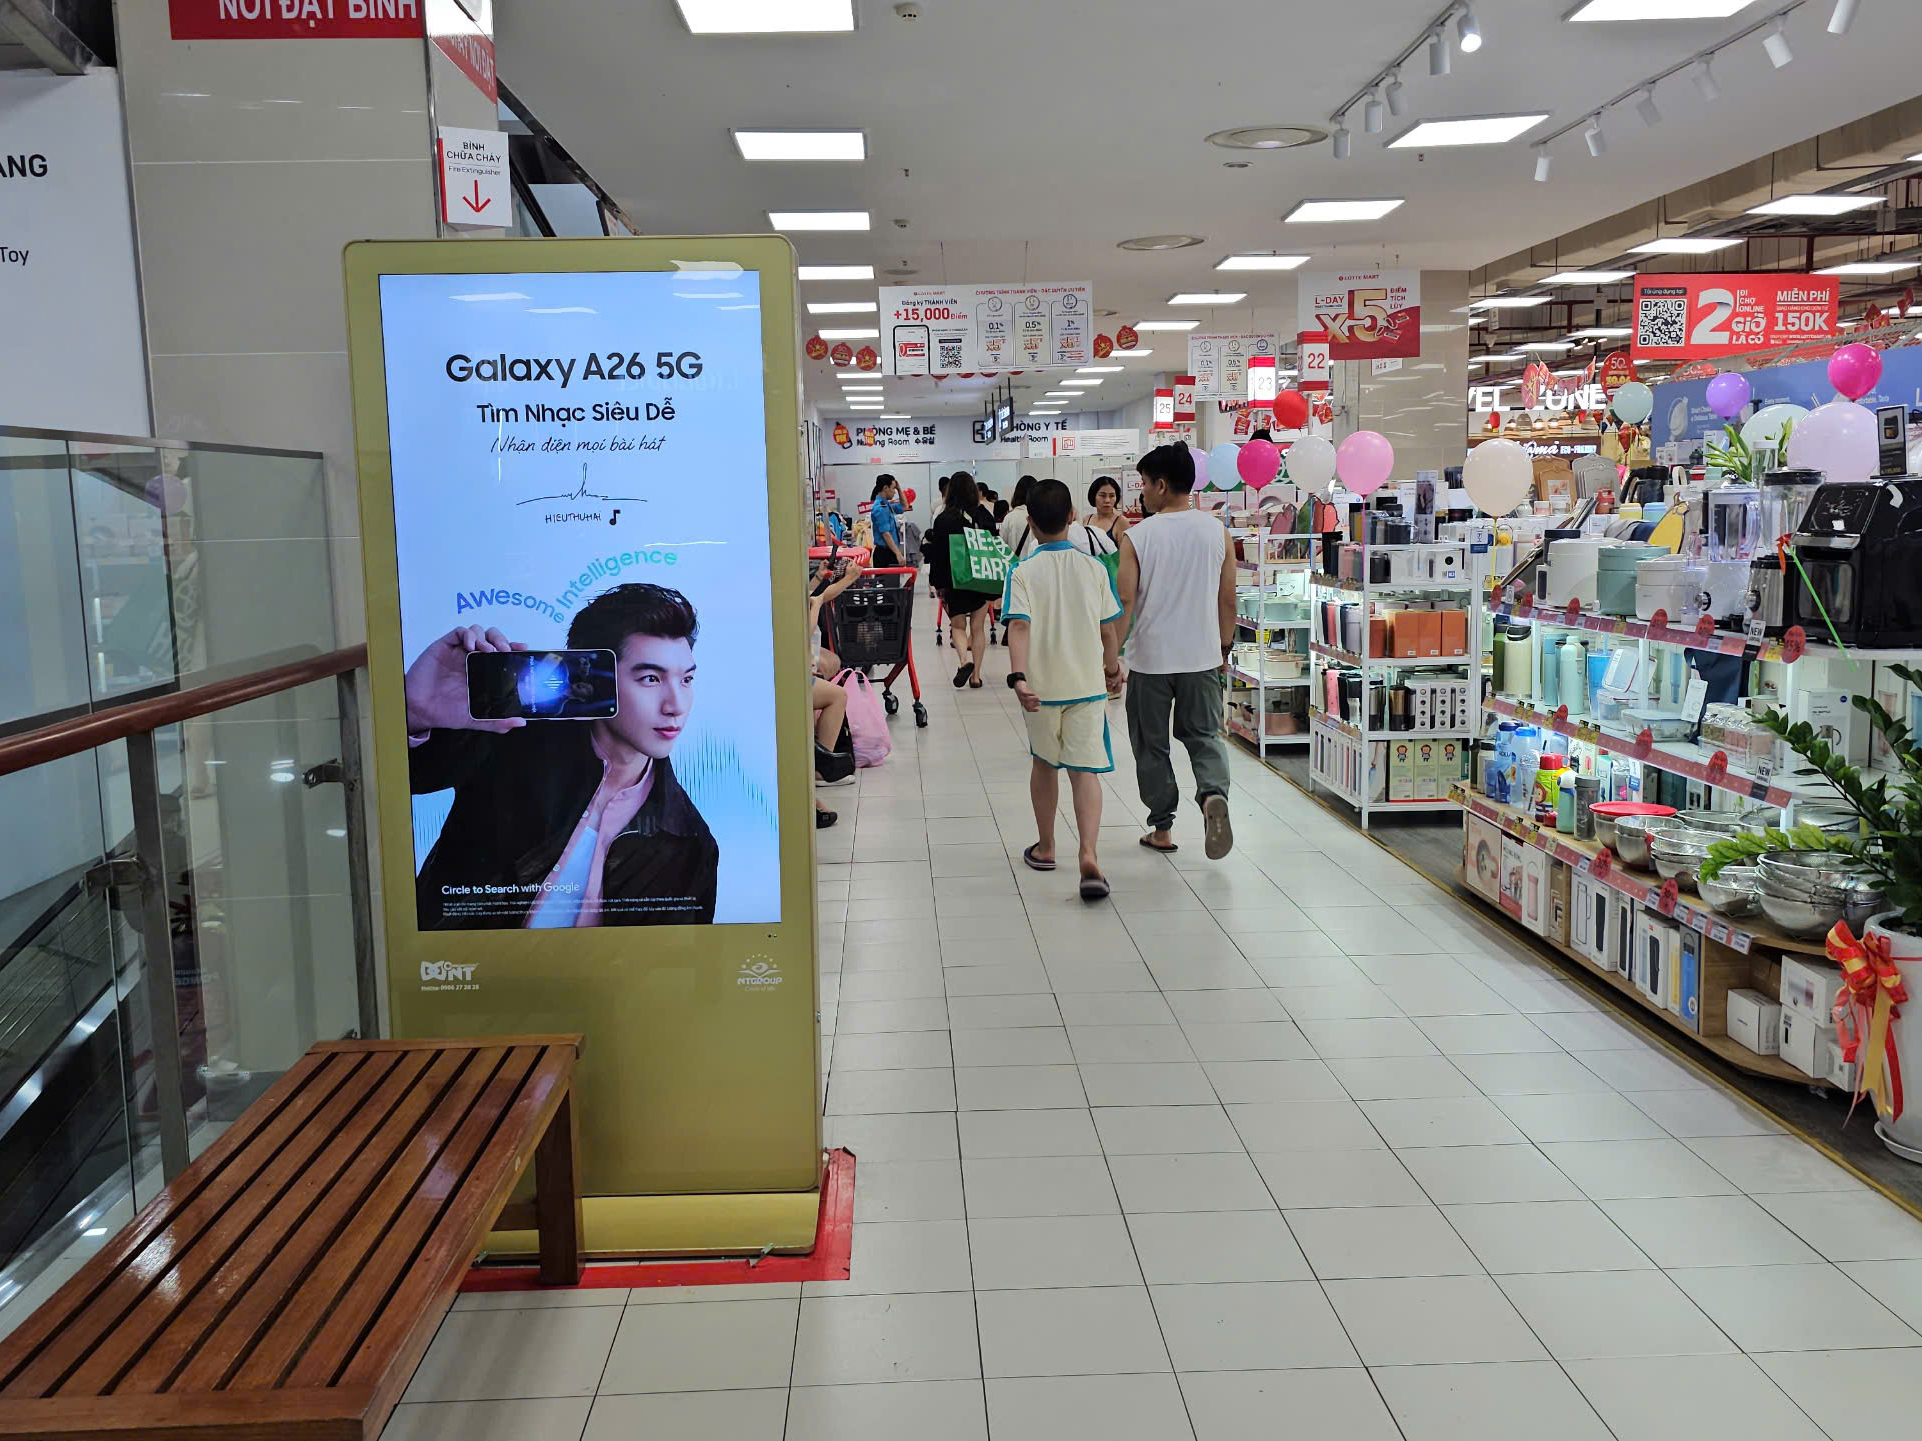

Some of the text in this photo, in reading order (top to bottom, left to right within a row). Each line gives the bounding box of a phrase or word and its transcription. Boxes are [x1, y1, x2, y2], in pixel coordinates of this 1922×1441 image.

[462, 140, 485, 151] BÌNH
[446, 150, 501, 163] CHỮA CHÁY
[461, 166, 501, 176] Extinguisher
[0, 246, 29, 266] Toy
[1314, 295, 1345, 305] L-DAY
[1776, 287, 1830, 302] MIỄN PHÍ
[893, 307, 968, 323] +15,000 Điểm
[1738, 305, 1765, 313] ONLINE
[1690, 288, 1735, 345] 2
[1774, 311, 1830, 331] 150K
[1731, 331, 1764, 345] LÀ CÓ
[1307, 352, 1326, 369] 22
[445, 350, 704, 389] Galaxy A26 5G
[1258, 376, 1273, 391] 23
[1178, 392, 1193, 405] 24
[476, 397, 676, 428] Tìm Nhạc Siêu Dễ
[1159, 402, 1171, 414] 25
[895, 426, 911, 437] MẸ
[912, 427, 920, 436] &
[922, 424, 936, 435] BÉ
[1043, 422, 1051, 431] Y
[1054, 418, 1068, 431] TẾ
[491, 434, 667, 454] Nhận diện mọi bài hát
[887, 437, 910, 446] Room
[1028, 434, 1049, 443] Room
[545, 512, 601, 524] HIEUTHUHAI
[456, 550, 678, 624] Awesome Intelligence
[1750, 627, 1763, 636] NEW
[1758, 765, 1771, 776] NEW
[441, 881, 580, 895] Circle to Search with Google
